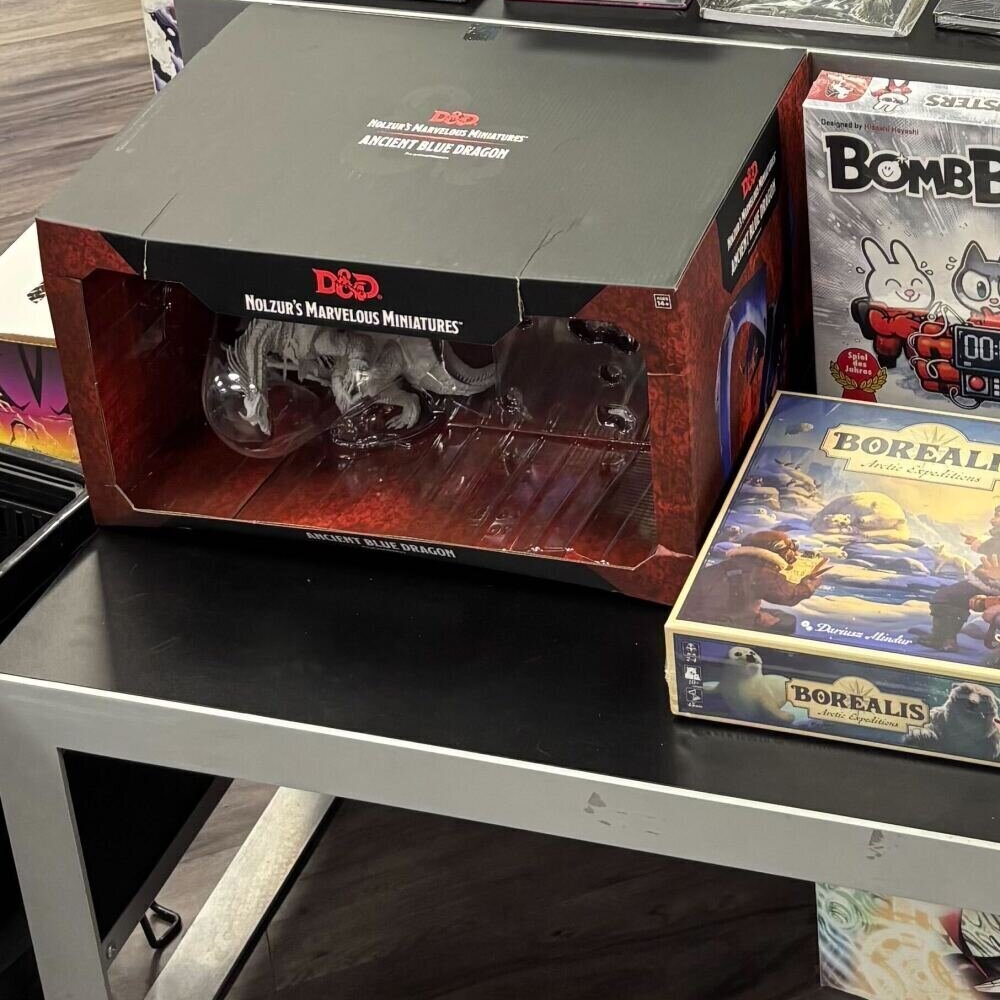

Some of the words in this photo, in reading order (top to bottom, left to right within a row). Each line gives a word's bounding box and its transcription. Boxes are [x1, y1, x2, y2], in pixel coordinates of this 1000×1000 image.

[428, 109, 481, 127] D&D
[820, 118, 852, 130] Designed
[853, 121, 863, 130] by
[891, 125, 919, 137] Hayashi
[411, 123, 467, 138] MARVELOUS
[358, 134, 418, 151] ANCIENT
[416, 140, 452, 154] BLUE
[452, 145, 510, 159] DRAGON
[311, 267, 381, 302] D&D
[244, 294, 303, 318] NOLZUR'S
[305, 301, 380, 326] MARVELOUS
[847, 351, 868, 362] Spiel
[853, 359, 867, 369] des
[844, 364, 873, 376] Jahres
[860, 457, 903, 472] Arctic
[906, 461, 983, 483] Expeditions
[305, 531, 361, 545] ANCIENT
[363, 538, 399, 550] BLUE
[399, 542, 457, 558] DRAGON
[816, 622, 863, 638] Dariusz
[866, 629, 914, 647] Mindur
[790, 683, 926, 721] BOREALIS
[847, 713, 900, 729] Expeditions
